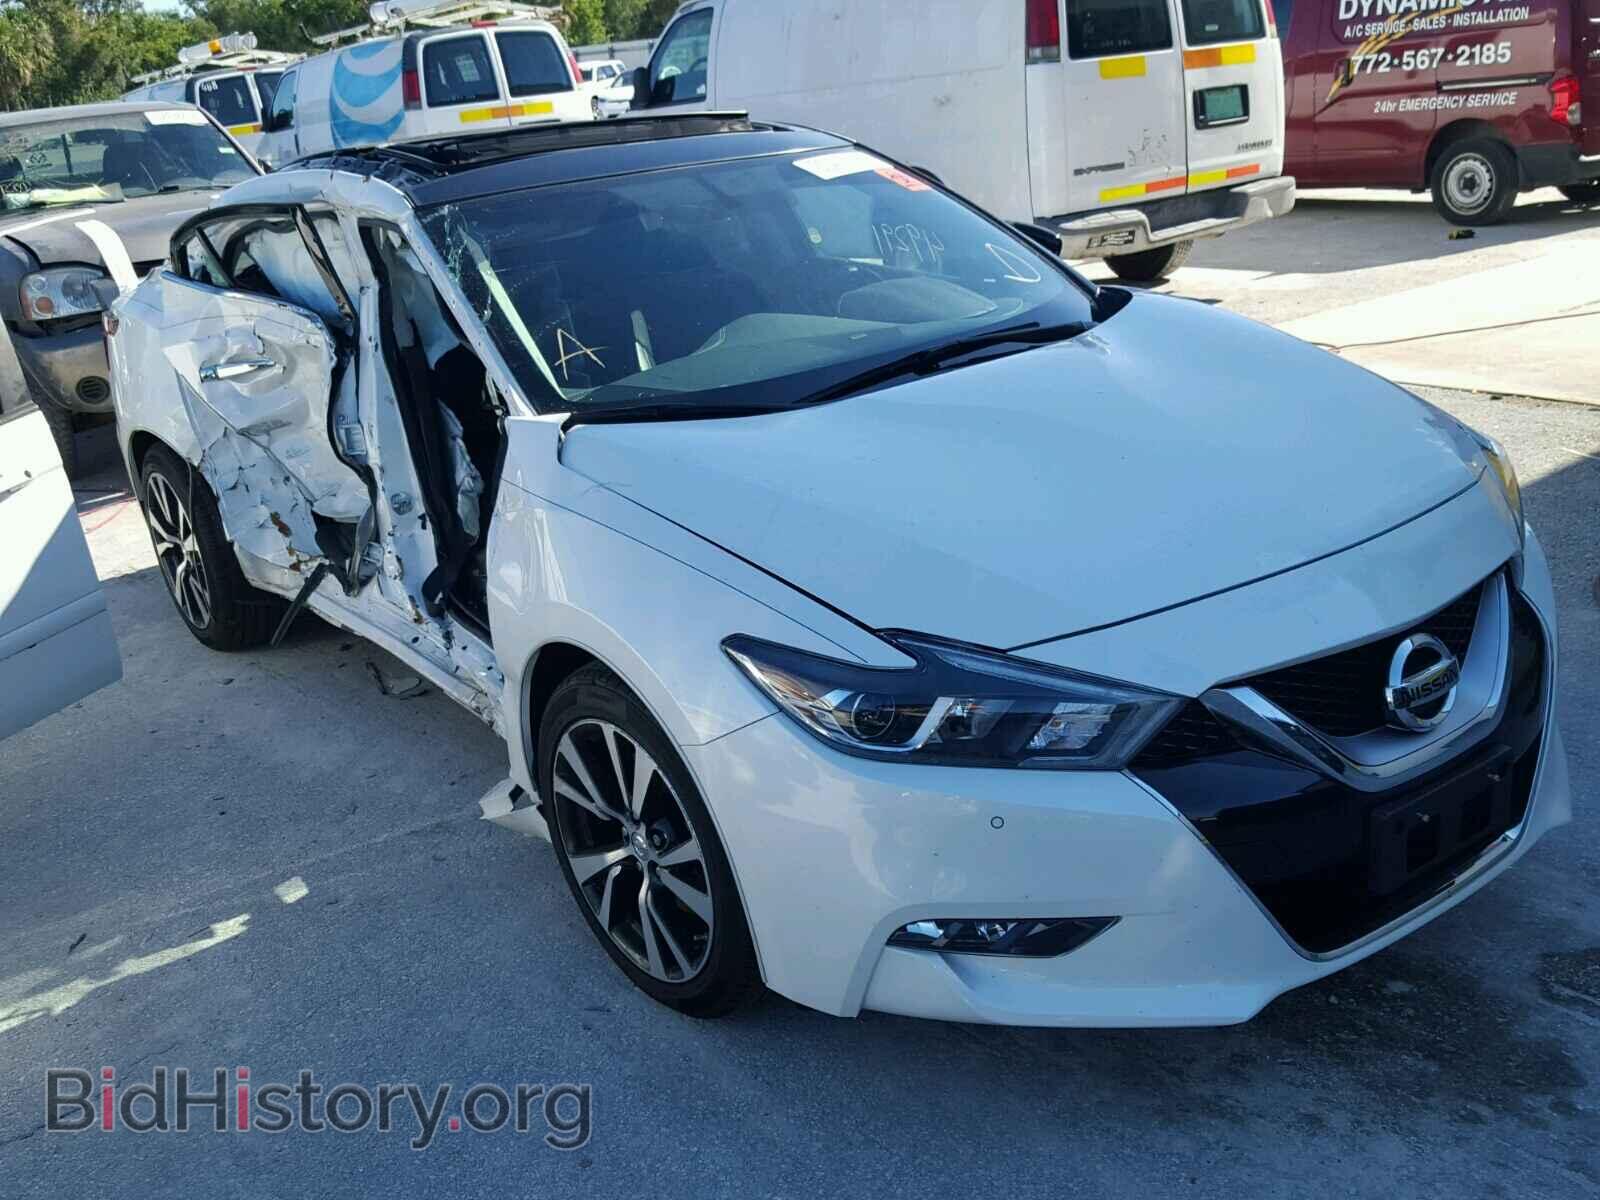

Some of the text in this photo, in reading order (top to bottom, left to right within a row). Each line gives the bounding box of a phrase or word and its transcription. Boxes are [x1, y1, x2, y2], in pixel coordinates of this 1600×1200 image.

[1338, 0, 1478, 21] DYNA
[1344, 7, 1530, 38] A/C SERVICE SALES INSTALLATION
[1374, 91, 1518, 113] 24hr EMERGENCY SERVICE
[554, 327, 609, 381] A
[1406, 670, 1458, 699] NISSAN
